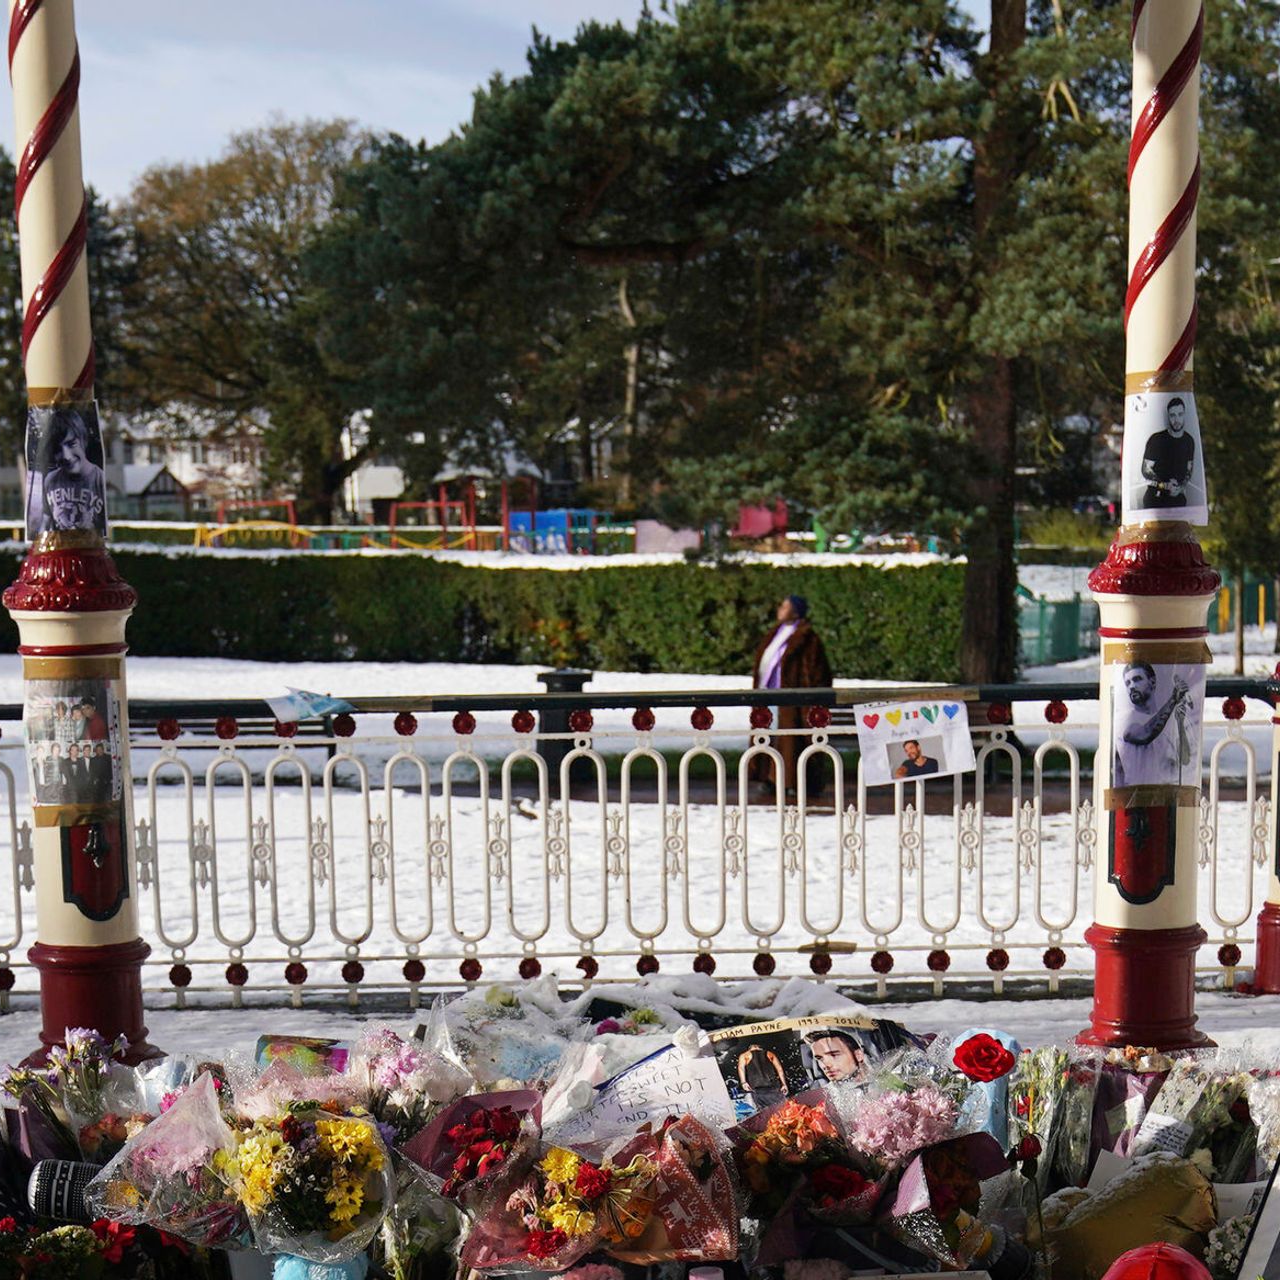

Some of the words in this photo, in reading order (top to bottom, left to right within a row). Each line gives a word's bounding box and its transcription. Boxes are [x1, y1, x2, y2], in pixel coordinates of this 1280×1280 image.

[47, 487, 104, 514] HENLEYS
[751, 1021, 782, 1033] PAYNE
[798, 1018, 820, 1027] 1993
[834, 1017, 861, 1027] 2024
[663, 1076, 705, 1097] NOT
